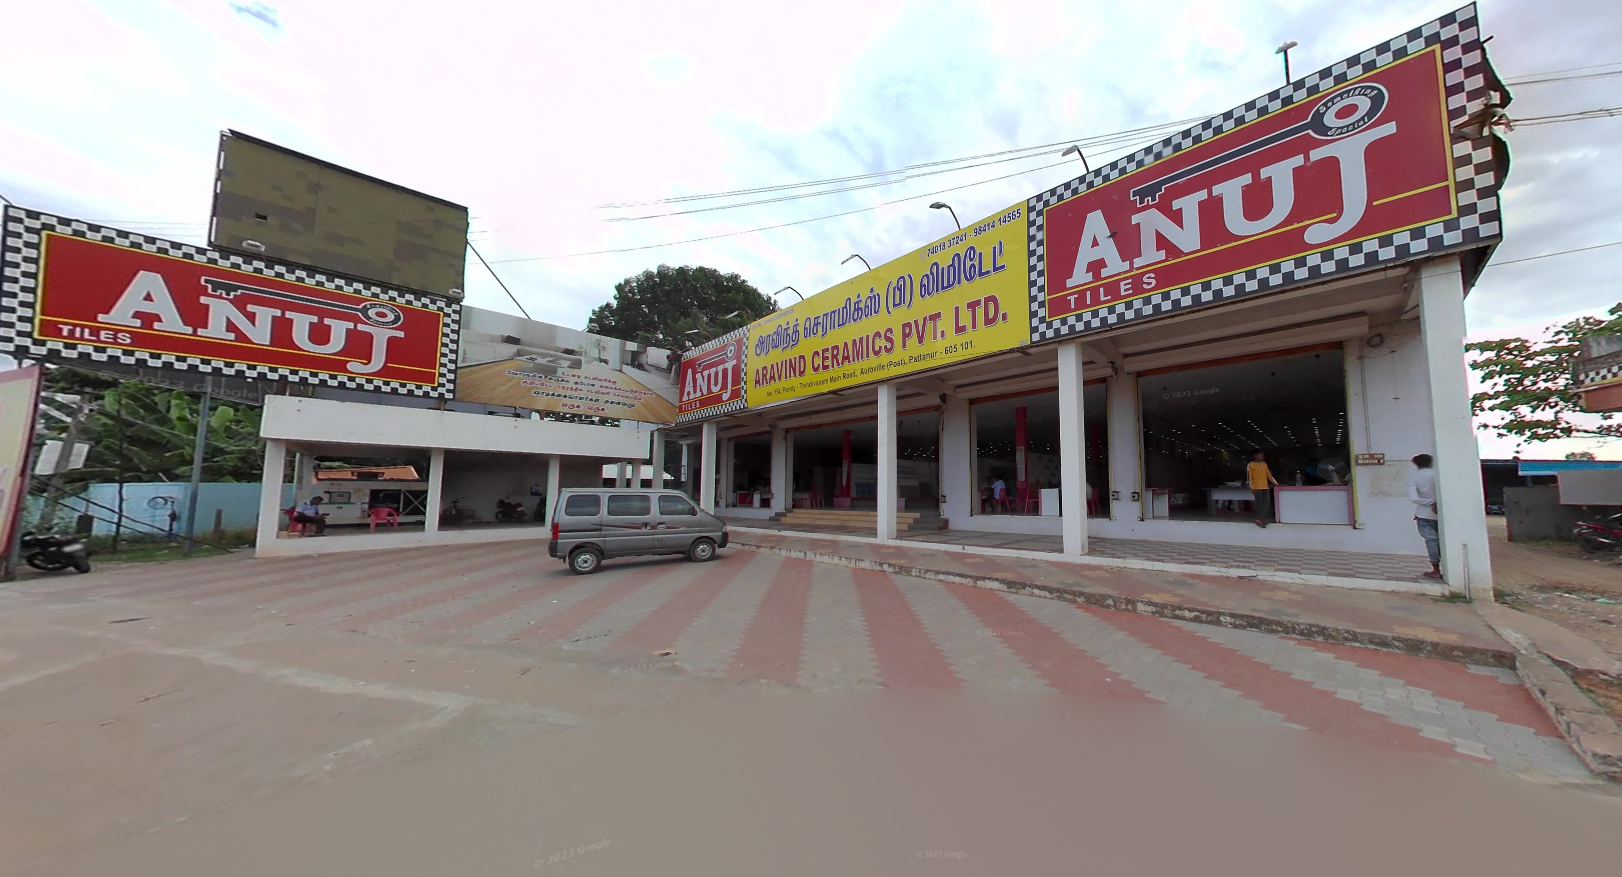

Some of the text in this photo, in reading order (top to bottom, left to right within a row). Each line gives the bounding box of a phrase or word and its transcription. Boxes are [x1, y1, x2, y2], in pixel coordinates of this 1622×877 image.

[1318, 87, 1379, 114] Something
[1327, 116, 1369, 137] Special
[1066, 120, 1396, 288] ANUJ
[927, 241, 946, 257] 74018
[947, 232, 967, 248] 37241
[973, 219, 996, 237] 98414
[997, 207, 1022, 226] 14565
[1066, 271, 1157, 309] TILES
[57, 323, 132, 346] TILES
[97, 270, 405, 374] ANUJ
[754, 317, 800, 357] அரவிந்த்
[803, 286, 881, 338] செராமிக்ஸ்
[885, 273, 914, 315] (பி)
[754, 294, 1008, 388] ARAVIND CERAMICS PVT. LTD.
[682, 359, 737, 401] ANUJ
[829, 374, 842, 384] Main
[909, 350, 937, 364] Pattanur
[944, 343, 958, 355] 605
[682, 401, 700, 411] TILES
